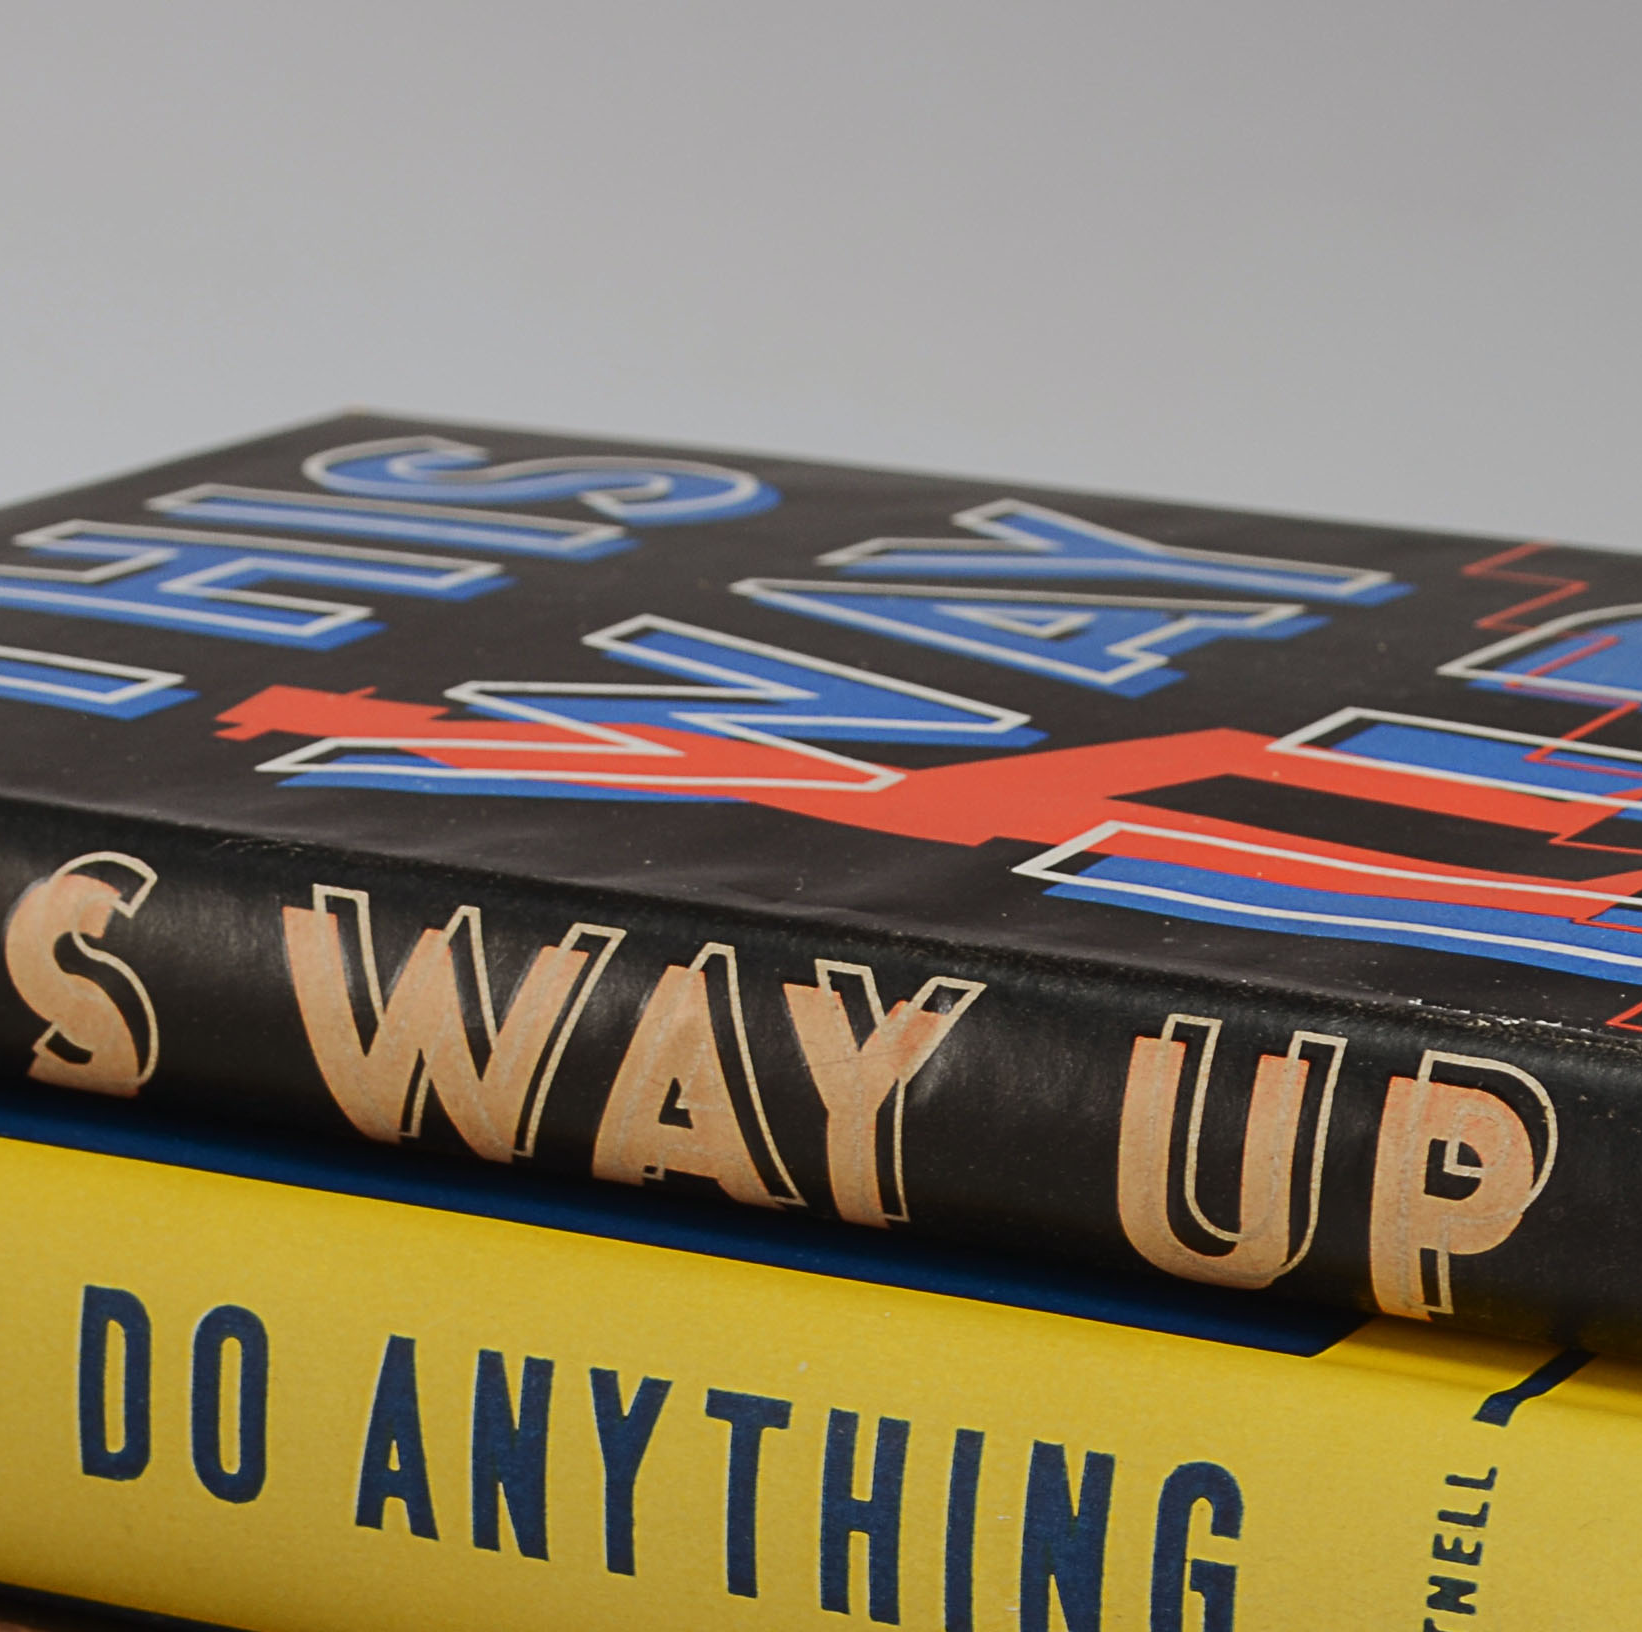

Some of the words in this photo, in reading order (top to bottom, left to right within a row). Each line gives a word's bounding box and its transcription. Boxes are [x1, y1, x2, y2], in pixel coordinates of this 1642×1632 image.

[255, 499, 1416, 800] WAY
[283, 884, 987, 1230] WAY
[1117, 1014, 1559, 1324] UP
[77, 1283, 269, 1505] DO
